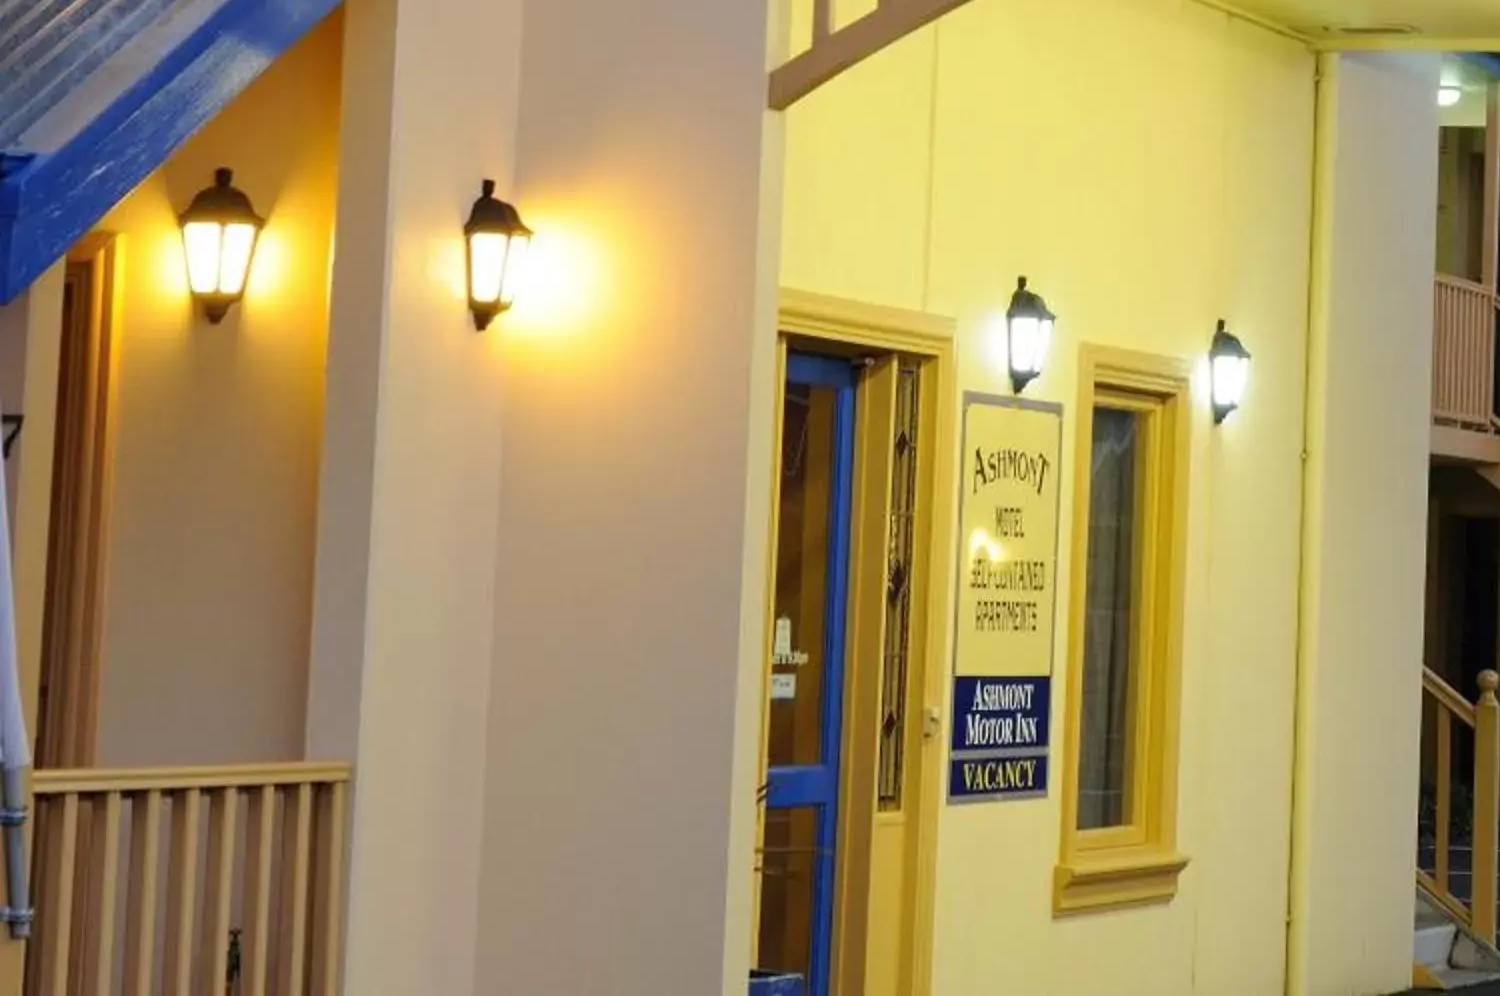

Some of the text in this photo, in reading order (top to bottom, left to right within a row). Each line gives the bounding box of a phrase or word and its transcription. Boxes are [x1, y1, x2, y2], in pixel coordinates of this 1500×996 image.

[972, 446, 1049, 496] ASHMONT
[994, 506, 1026, 540] MOTEL
[974, 601, 1038, 633] APARTMENTS
[971, 680, 1034, 712] ASHMONT
[966, 712, 1038, 745] MOTOR INN
[963, 758, 1036, 790] VACANCY
